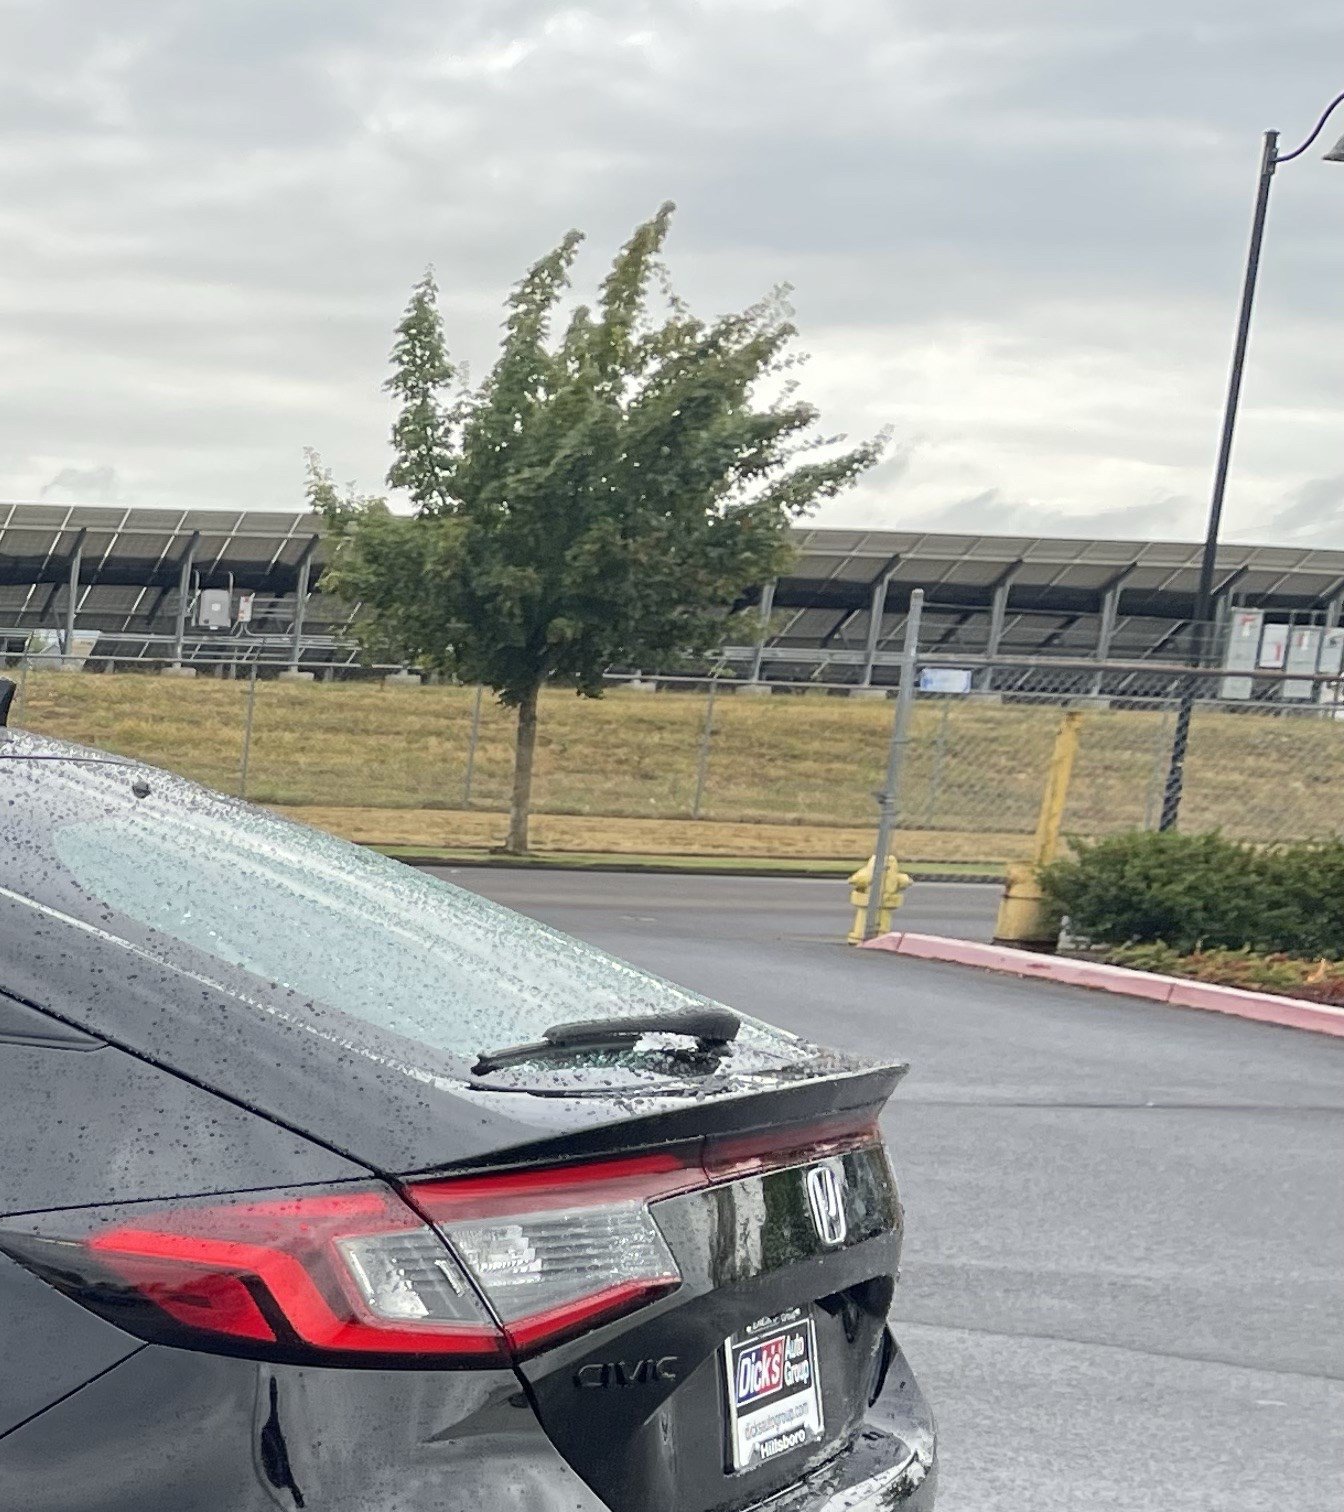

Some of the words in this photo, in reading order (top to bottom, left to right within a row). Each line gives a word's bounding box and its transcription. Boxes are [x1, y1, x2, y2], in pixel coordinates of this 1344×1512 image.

[573, 1355, 679, 1389] CIVIC
[739, 1343, 782, 1399] Dick's
[785, 1333, 806, 1360] Auto
[784, 1359, 810, 1386] Group
[760, 1429, 807, 1459] Hillsboro
